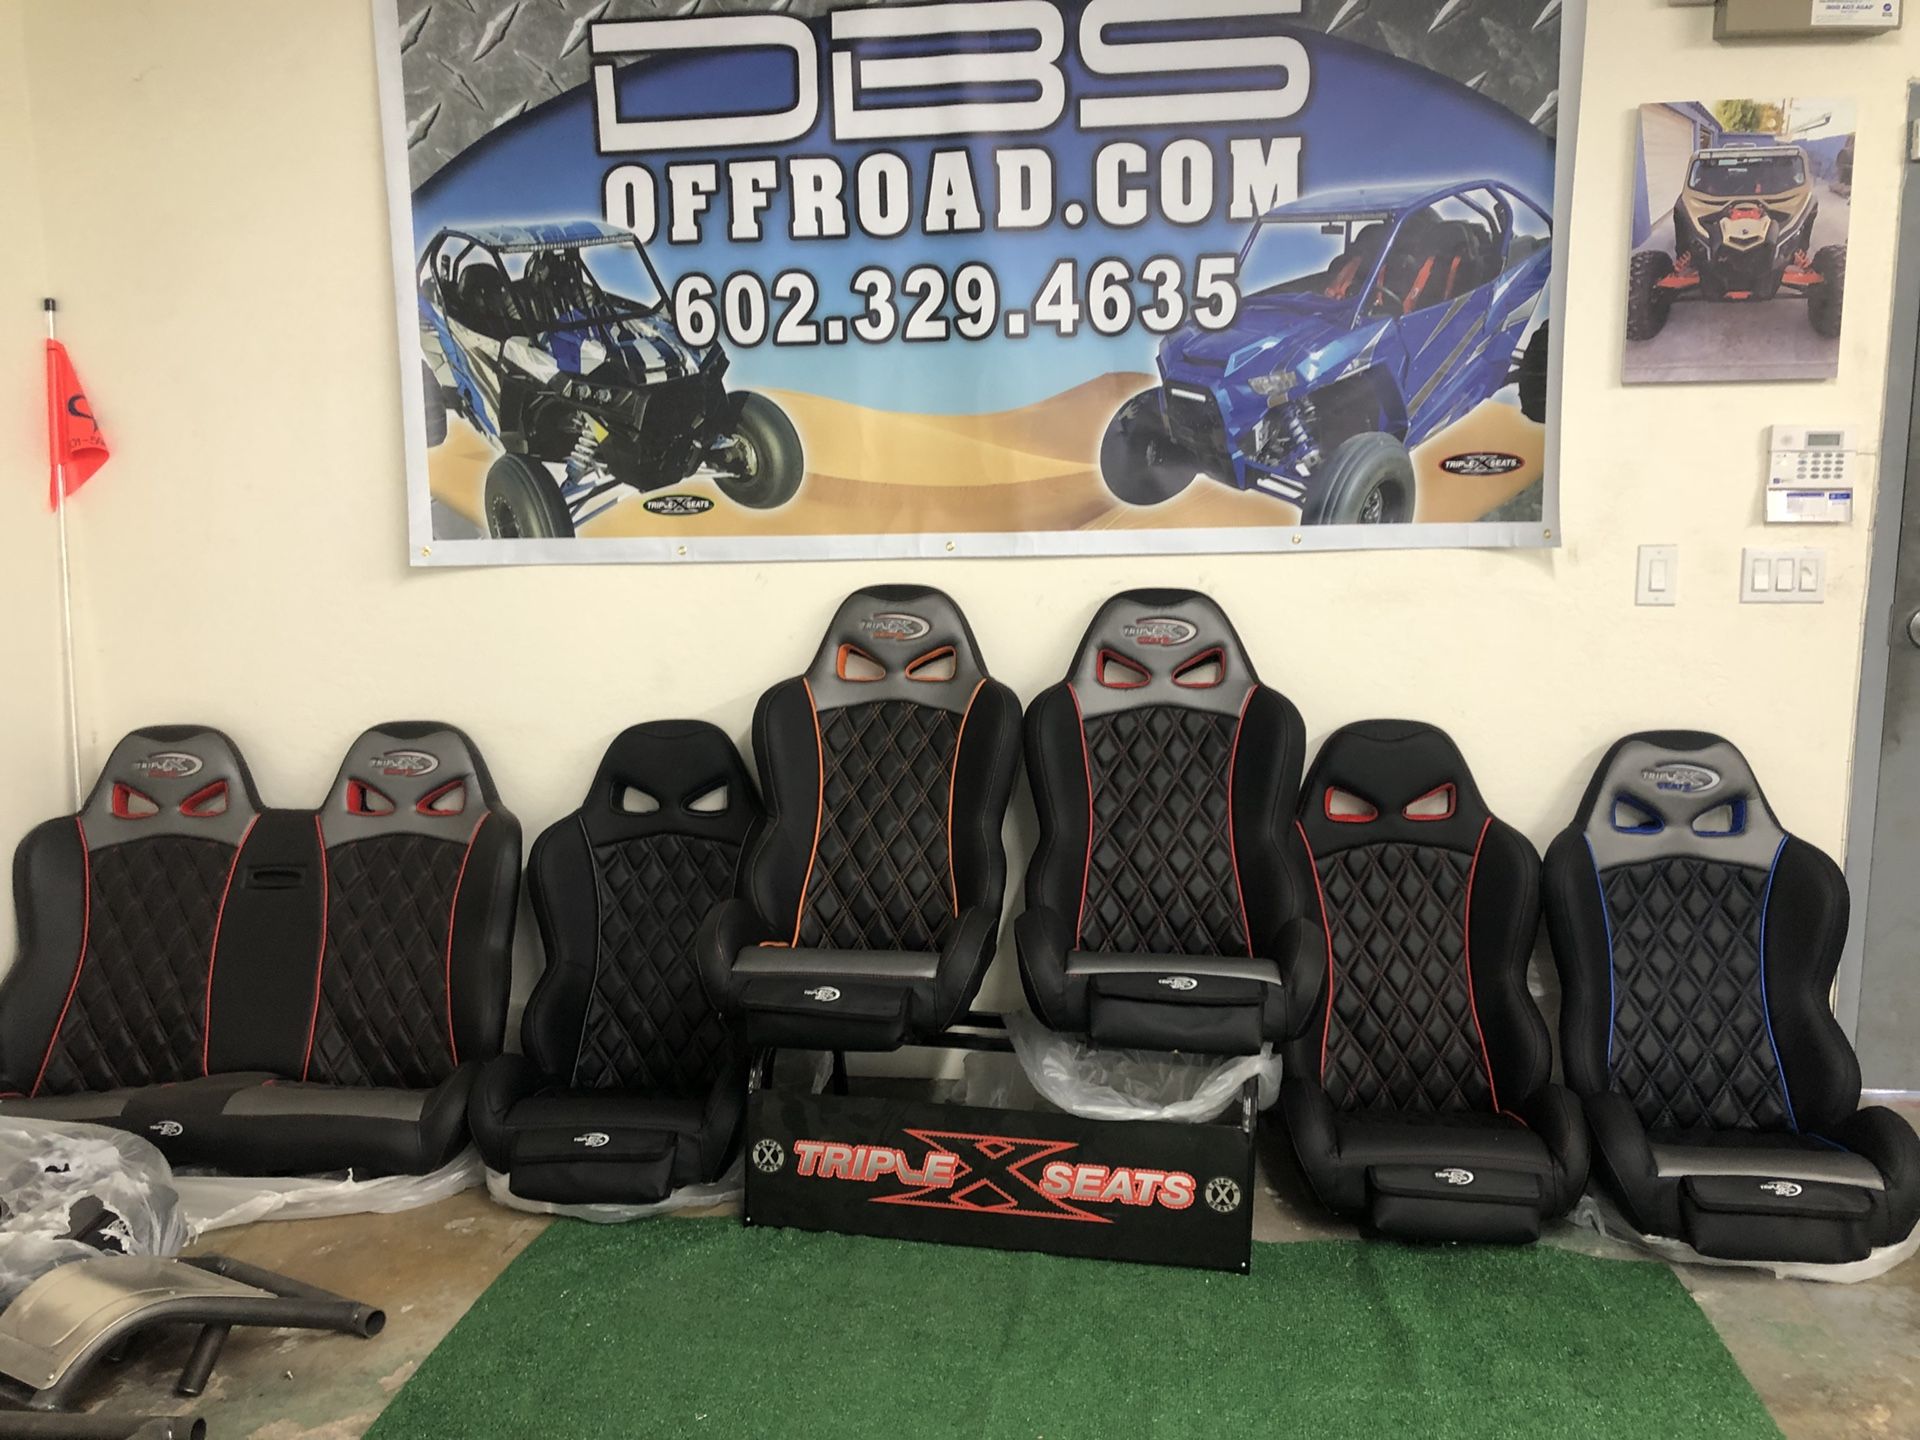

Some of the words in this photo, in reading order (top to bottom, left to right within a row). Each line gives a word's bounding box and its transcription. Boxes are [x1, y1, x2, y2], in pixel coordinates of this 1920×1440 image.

[592, 0, 1311, 152] DBS
[605, 136, 1302, 244] OFFROAD.COM
[674, 256, 1239, 346] 602.329.4635
[794, 1140, 960, 1188] TRIPLE
[1039, 1161, 1197, 1209] SEATS
